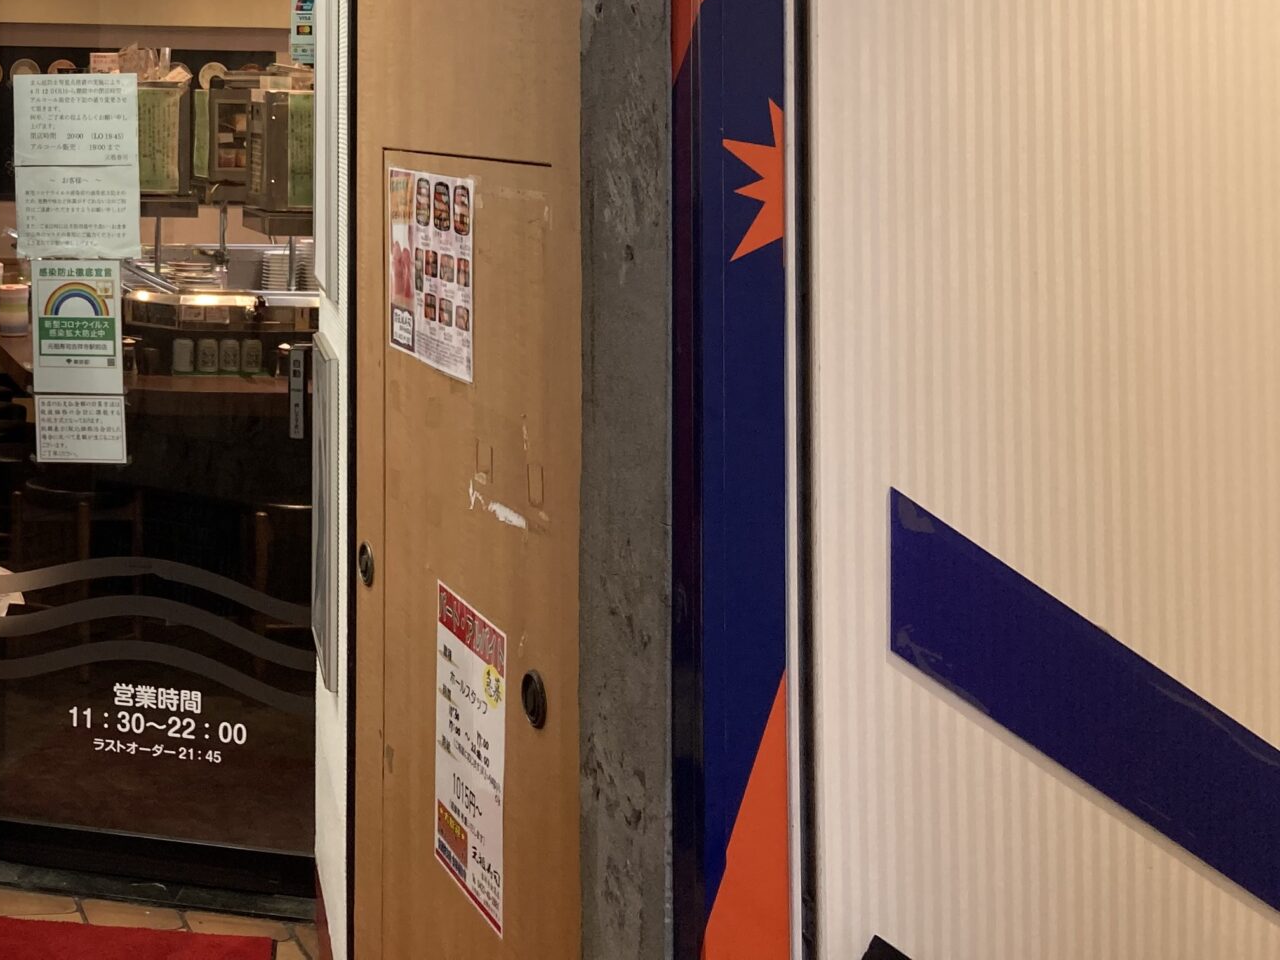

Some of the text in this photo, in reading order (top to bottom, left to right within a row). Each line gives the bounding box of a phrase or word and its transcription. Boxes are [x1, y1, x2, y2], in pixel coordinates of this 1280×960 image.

[38, 267, 113, 278] 感染防止徹底宣言
[44, 320, 110, 329] 新型コロナウイルス
[48, 329, 106, 338] 感染拡大防止中
[113, 682, 202, 714] 営業時間
